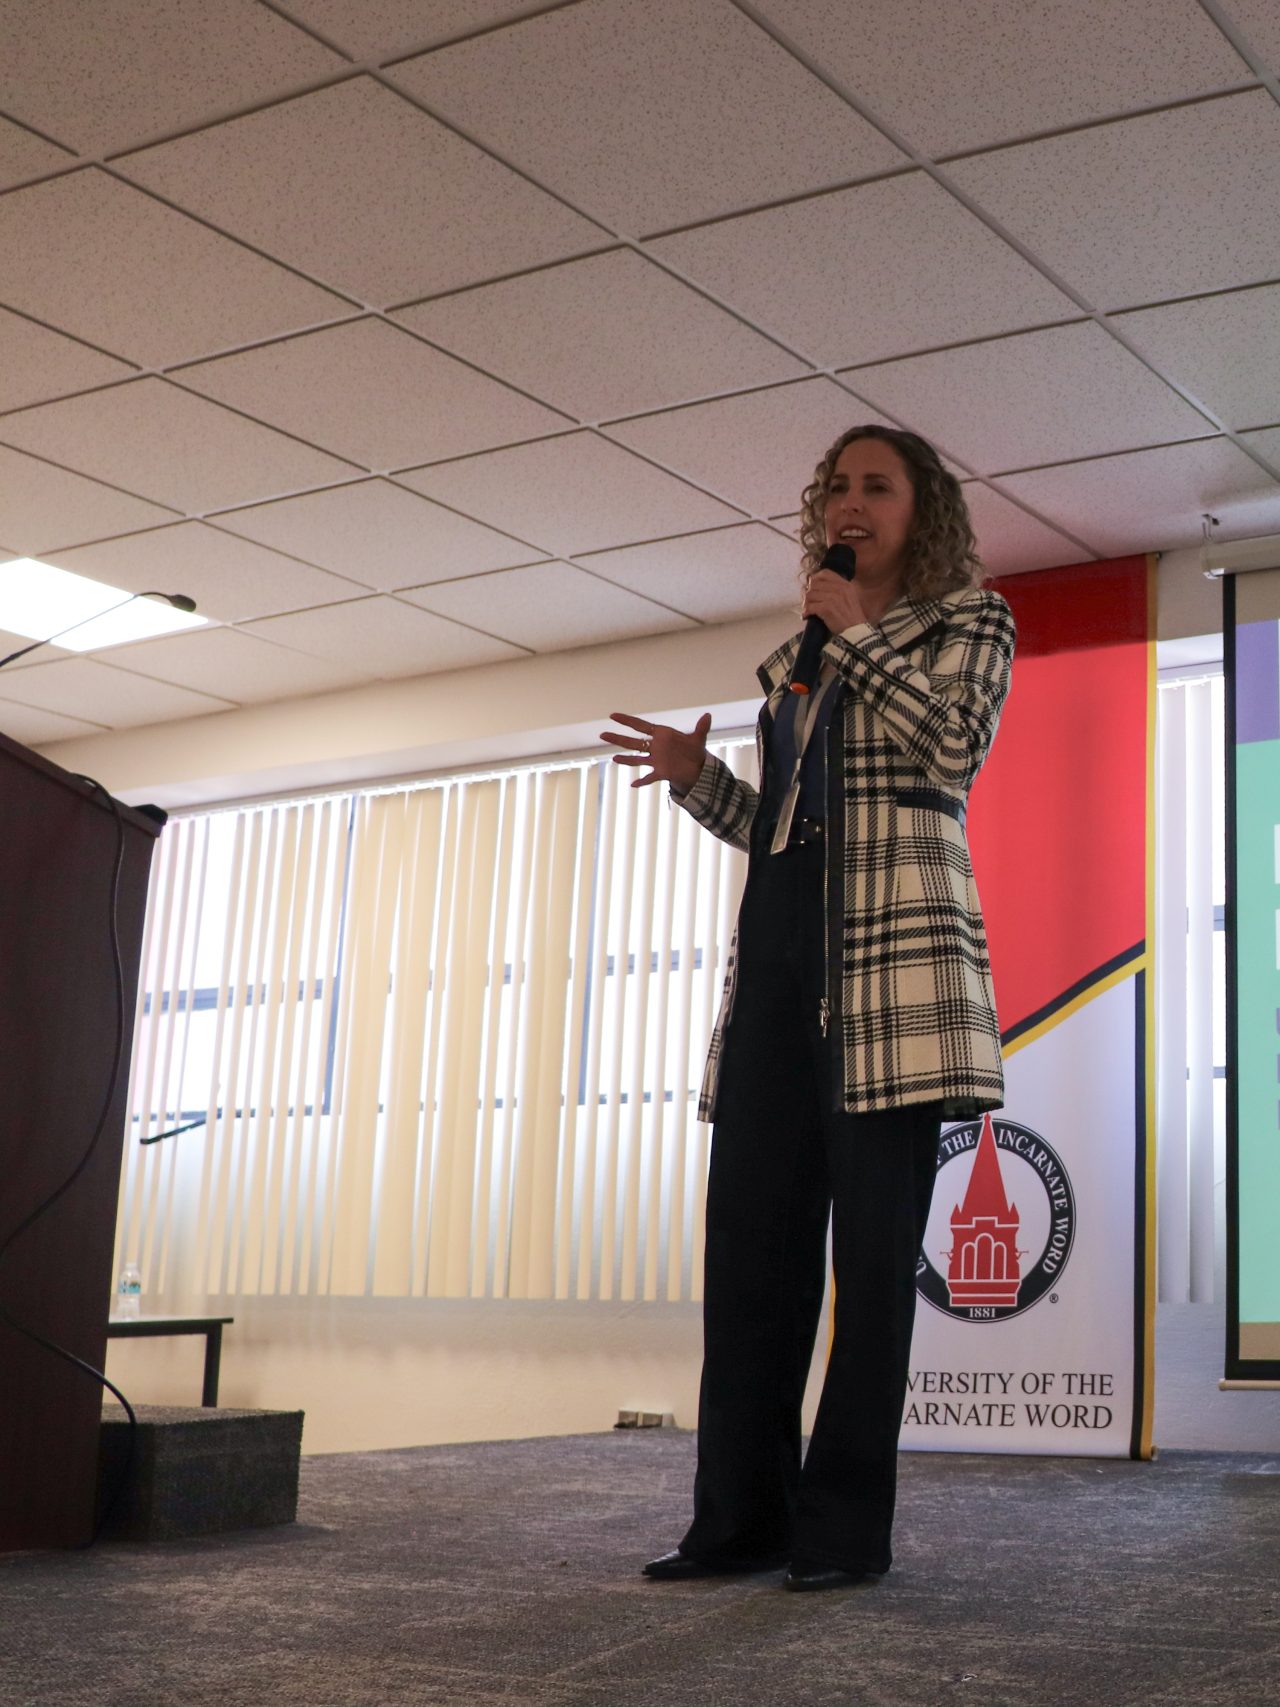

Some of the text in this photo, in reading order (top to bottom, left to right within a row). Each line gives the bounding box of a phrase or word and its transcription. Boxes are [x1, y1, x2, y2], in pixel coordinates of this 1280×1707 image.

[941, 1128, 1069, 1273] THE INCARNATE WORD
[968, 1307, 996, 1318] 1881
[907, 1372, 1114, 1396] VERSITY OF THE
[904, 1403, 1112, 1429] ARNATE WORD
